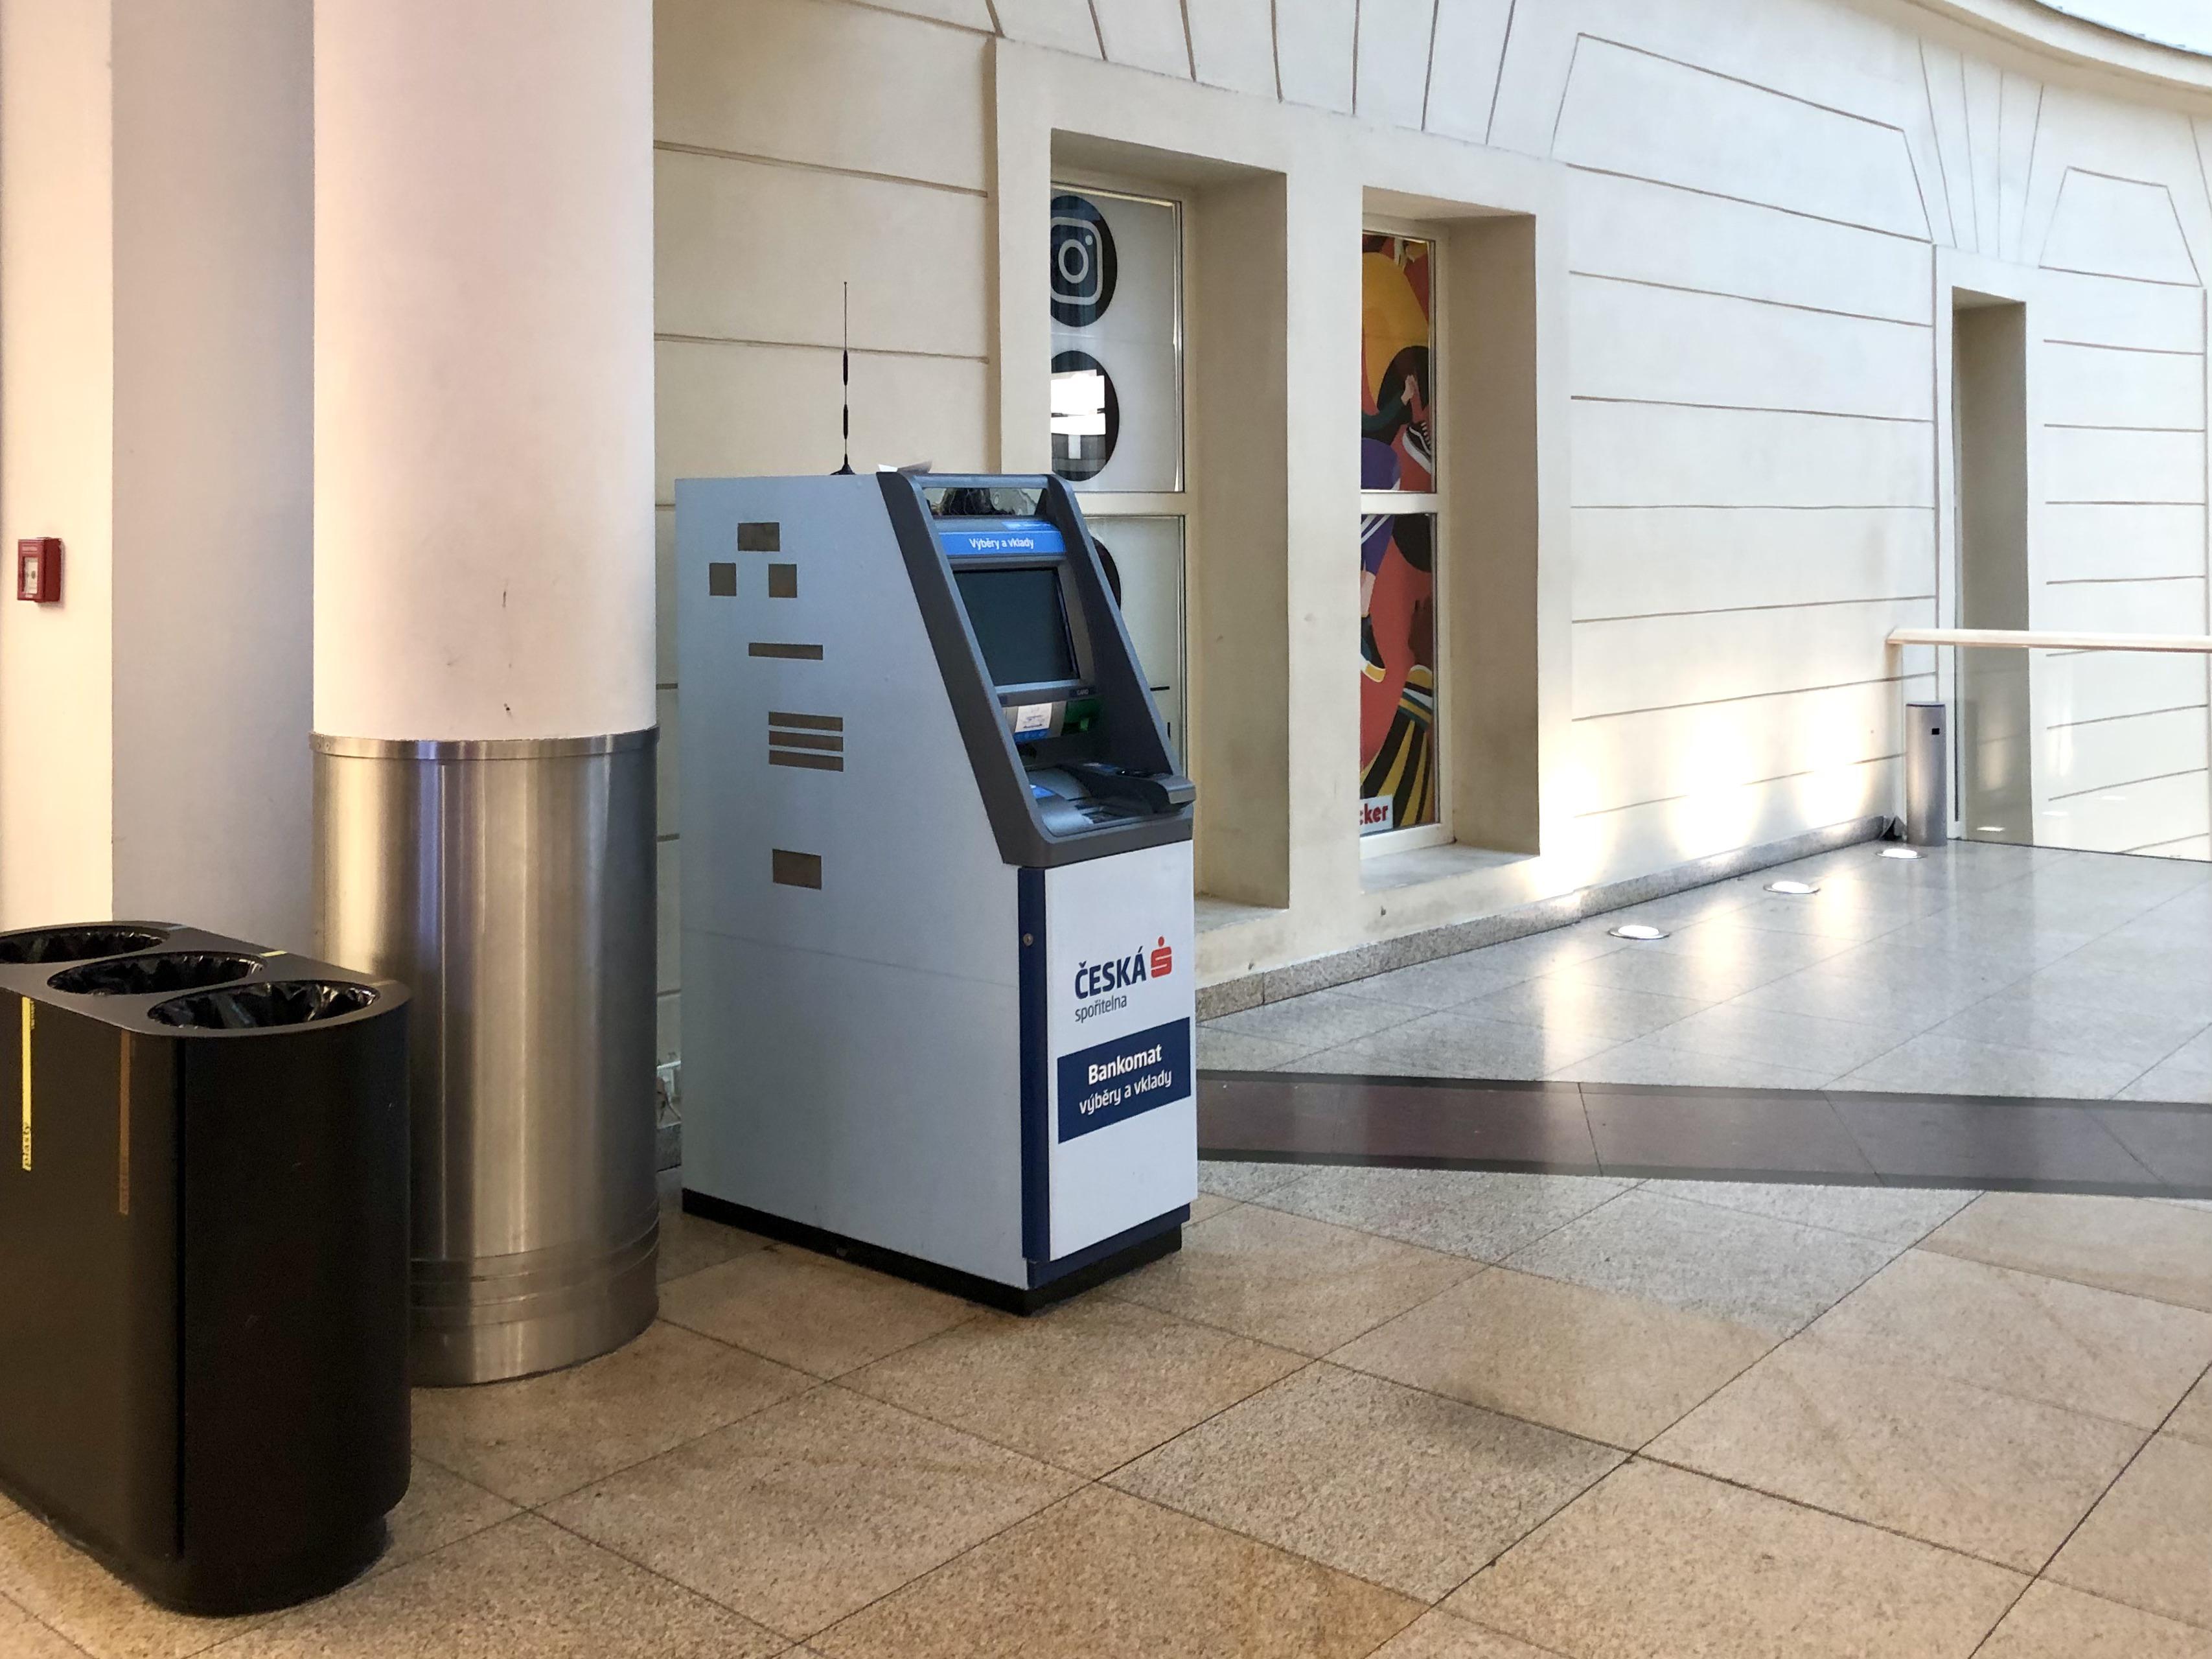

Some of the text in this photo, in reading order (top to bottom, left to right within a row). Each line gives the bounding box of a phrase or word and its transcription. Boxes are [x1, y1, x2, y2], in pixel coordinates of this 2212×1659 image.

[969, 537, 1000, 550] Výběry
[1008, 537, 1034, 550] vklady
[1074, 946, 1147, 1000] ČESKÁ
[1074, 995, 1127, 1024] spořitelna
[1088, 1043, 1162, 1085] Bankomat
[1079, 1069, 1172, 1115] výběry a vklady
